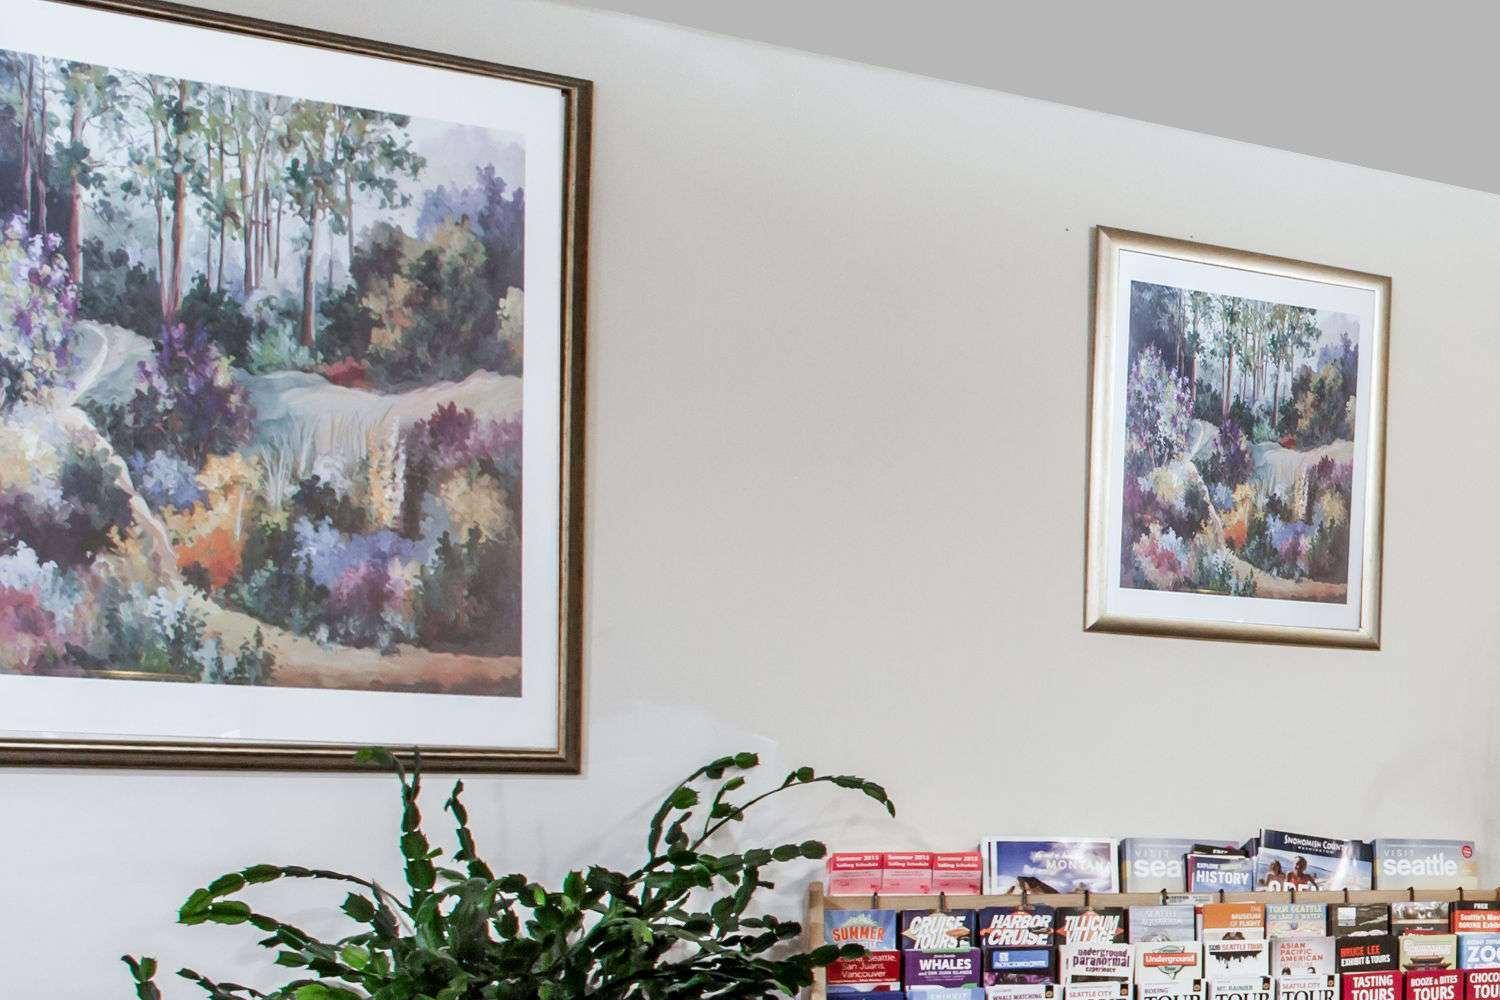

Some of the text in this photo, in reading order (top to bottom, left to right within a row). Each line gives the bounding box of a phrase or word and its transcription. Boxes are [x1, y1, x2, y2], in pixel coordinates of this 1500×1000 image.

[1383, 854, 1458, 877] seattle
[1196, 872, 1249, 884] HISTORY
[910, 916, 966, 935] CRUISE
[990, 915, 1052, 928] HARBOR
[1064, 916, 1120, 930] TILLICUM
[832, 927, 886, 941] SUMMER
[988, 928, 1048, 945] CRUISE
[1367, 945, 1381, 955] LEE
[1073, 956, 1129, 968] paranormal
[1145, 954, 1195, 964] Underground
[1281, 954, 1323, 962] AMERICAN
[919, 959, 972, 970] WHALES
[842, 970, 886, 978] Vancouver
[1352, 975, 1393, 988] TASTING
